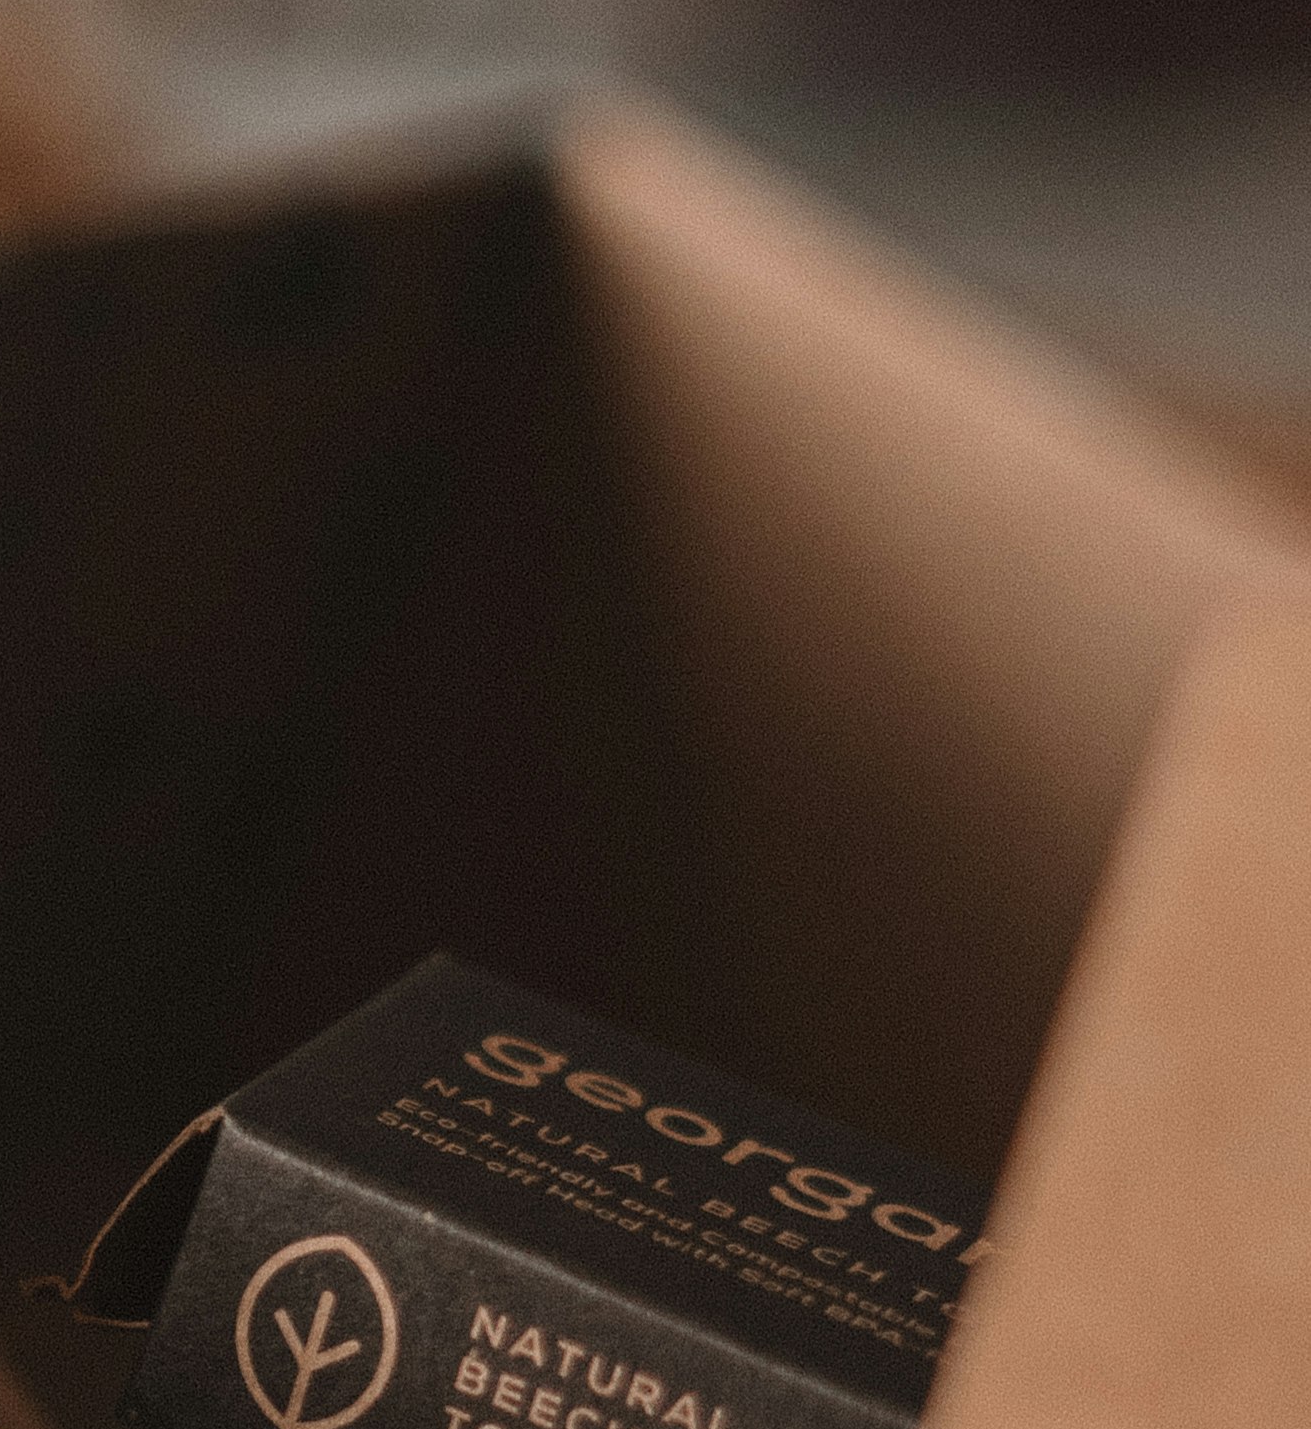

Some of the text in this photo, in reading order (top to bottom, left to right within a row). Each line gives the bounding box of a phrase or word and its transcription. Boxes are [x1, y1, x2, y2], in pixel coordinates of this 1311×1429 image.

[378, 1111, 542, 1185] Snap-off
[546, 1184, 643, 1232] Head
[651, 1231, 730, 1269] with
[739, 1267, 815, 1308] Soft
[395, 1098, 936, 1337] Eco-friendly and Compostable
[423, 1077, 674, 1196] NATURAL
[701, 1199, 884, 1283] BEECH
